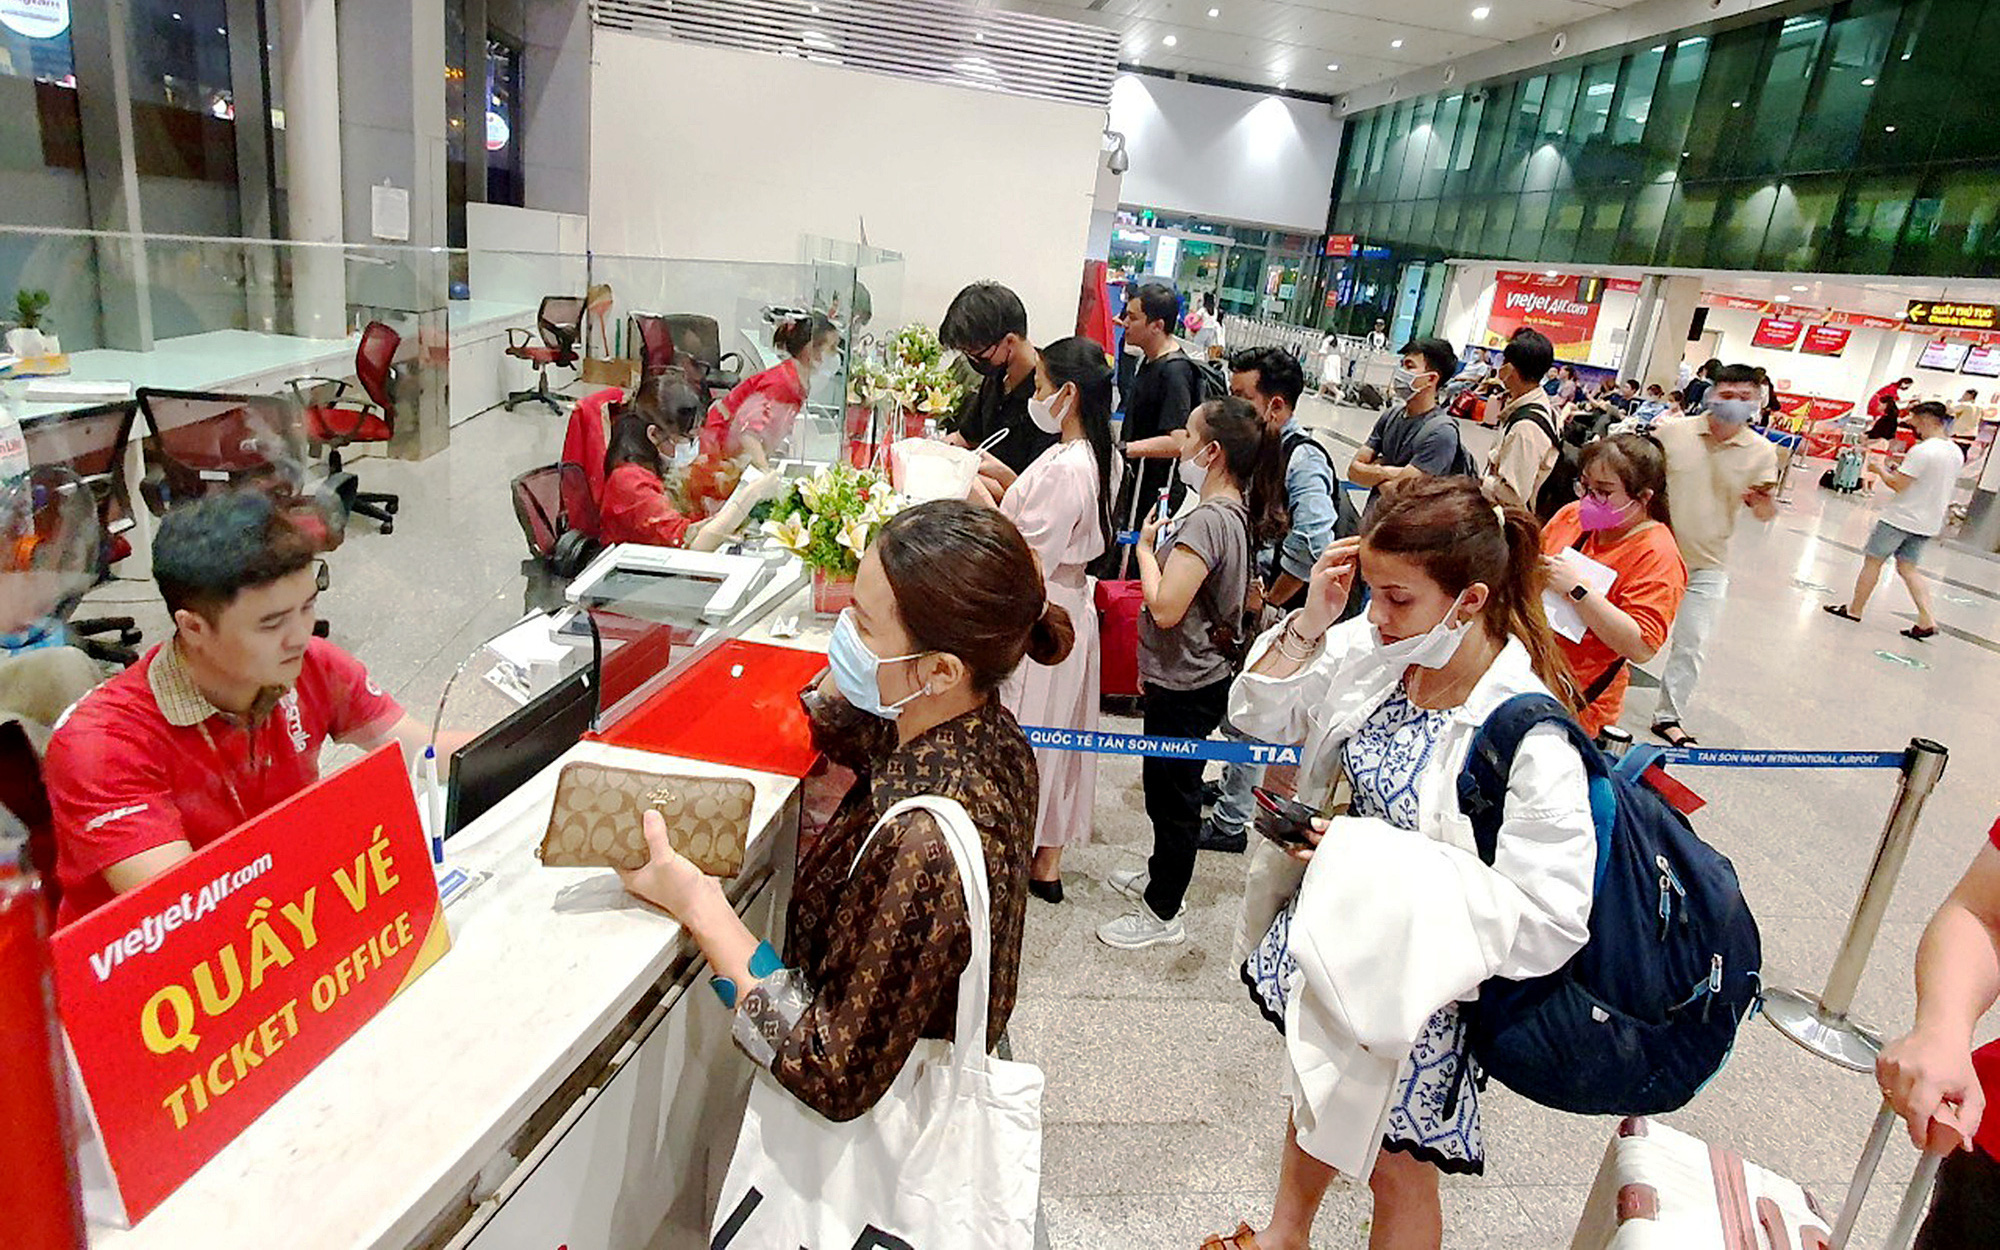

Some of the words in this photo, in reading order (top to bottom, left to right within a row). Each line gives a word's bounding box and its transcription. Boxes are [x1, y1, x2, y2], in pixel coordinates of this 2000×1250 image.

[1030, 730, 1071, 745] QUỐC
[1076, 731, 1093, 746] TẾ
[1098, 735, 1125, 749] TÂN
[1698, 752, 1716, 762] TAN
[1717, 753, 1740, 763] SON
[1740, 753, 1767, 763] NHAT
[1766, 754, 1838, 764] INTERNATIONAL
[1838, 755, 1880, 764] AIRPORT
[141, 887, 318, 1054] QUẦY
[332, 824, 400, 913] VÉ
[162, 998, 298, 1130] TICKET
[311, 912, 414, 1014] OFFICE
